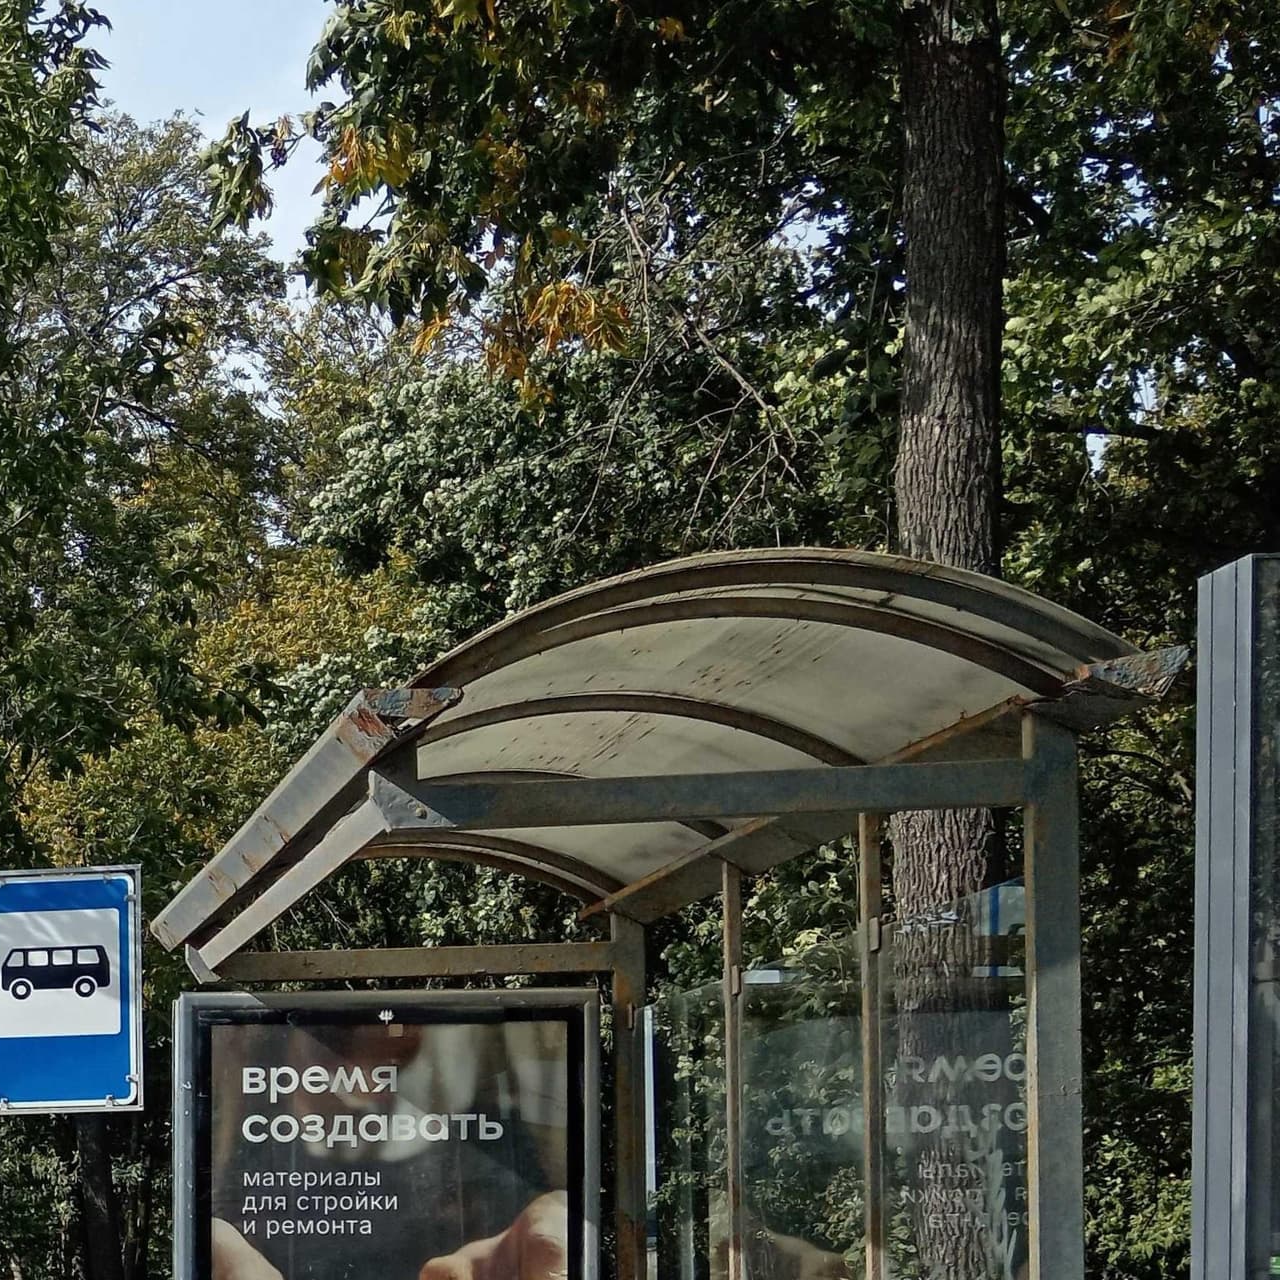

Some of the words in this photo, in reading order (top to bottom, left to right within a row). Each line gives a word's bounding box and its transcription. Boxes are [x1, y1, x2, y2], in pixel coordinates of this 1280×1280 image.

[242, 1065, 398, 1103] время
[241, 1113, 504, 1148] создавать
[242, 1171, 381, 1191] материалы
[241, 1195, 287, 1214] для
[296, 1190, 398, 1215] стройки
[243, 1219, 256, 1235] и
[266, 1218, 372, 1239] ремонта
